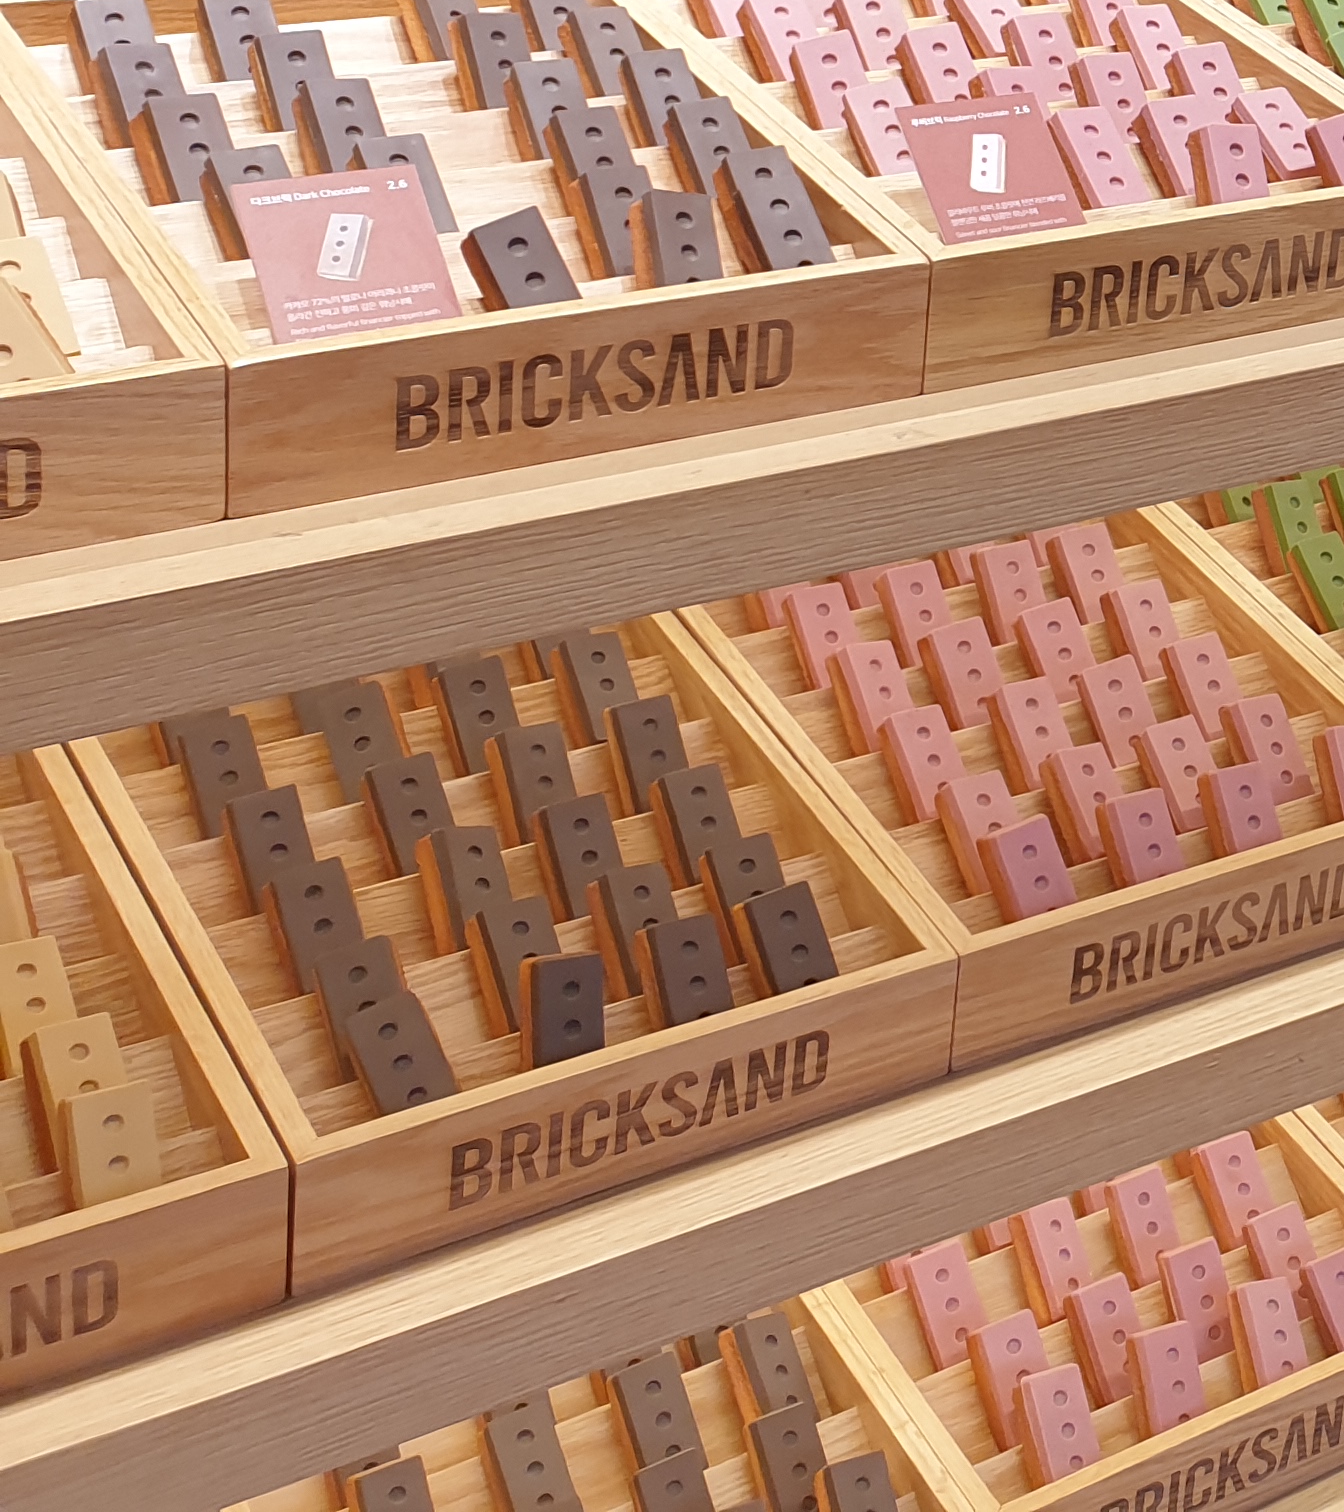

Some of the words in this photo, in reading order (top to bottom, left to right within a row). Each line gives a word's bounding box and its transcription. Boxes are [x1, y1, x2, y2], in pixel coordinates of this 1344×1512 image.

[1013, 105, 1031, 115] 2.6
[386, 179, 408, 189] 2.6
[293, 188, 318, 200] Dark
[319, 185, 370, 198] Chocolate
[396, 318, 794, 451] BRICKSAND
[449, 1029, 830, 1211] BRICKSAND
